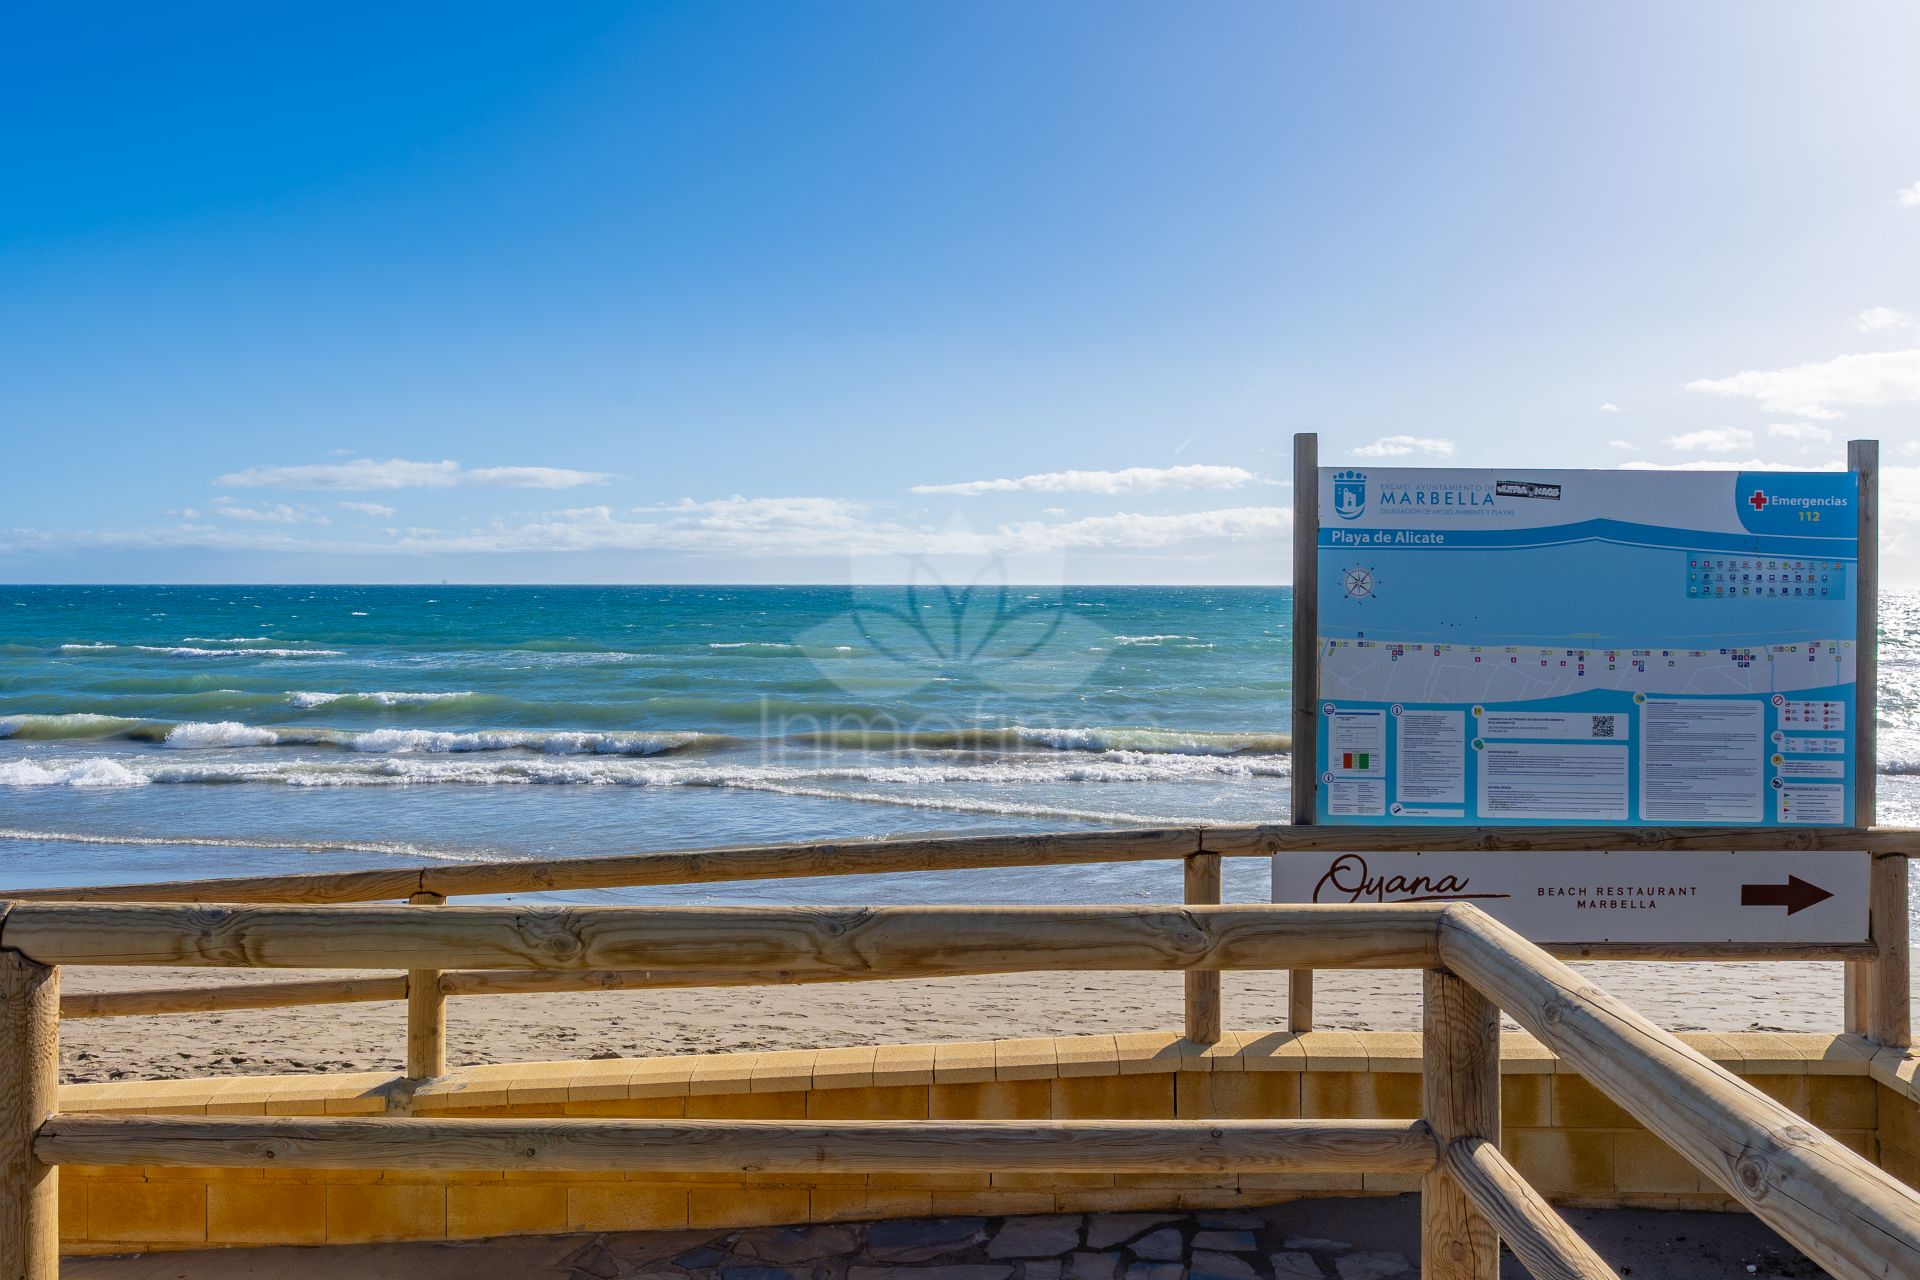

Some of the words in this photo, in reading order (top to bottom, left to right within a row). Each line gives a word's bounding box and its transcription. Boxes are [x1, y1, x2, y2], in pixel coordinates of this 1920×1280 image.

[1416, 484, 1482, 492] AYUNTAMIENTO
[1380, 491, 1495, 505] MARBELLA
[1771, 495, 1848, 509] Emergencias
[1433, 508, 1454, 516] MEDIO
[1798, 511, 1821, 522] 112
[1331, 530, 1370, 546] Playa
[1373, 530, 1392, 543] de
[1395, 531, 1445, 544] Alicate
[1312, 853, 1470, 904] Oyana
[1537, 887, 1587, 897] BEACH
[1596, 887, 1698, 897] RESTAURANT
[1577, 899, 1657, 909] MARBELLA
